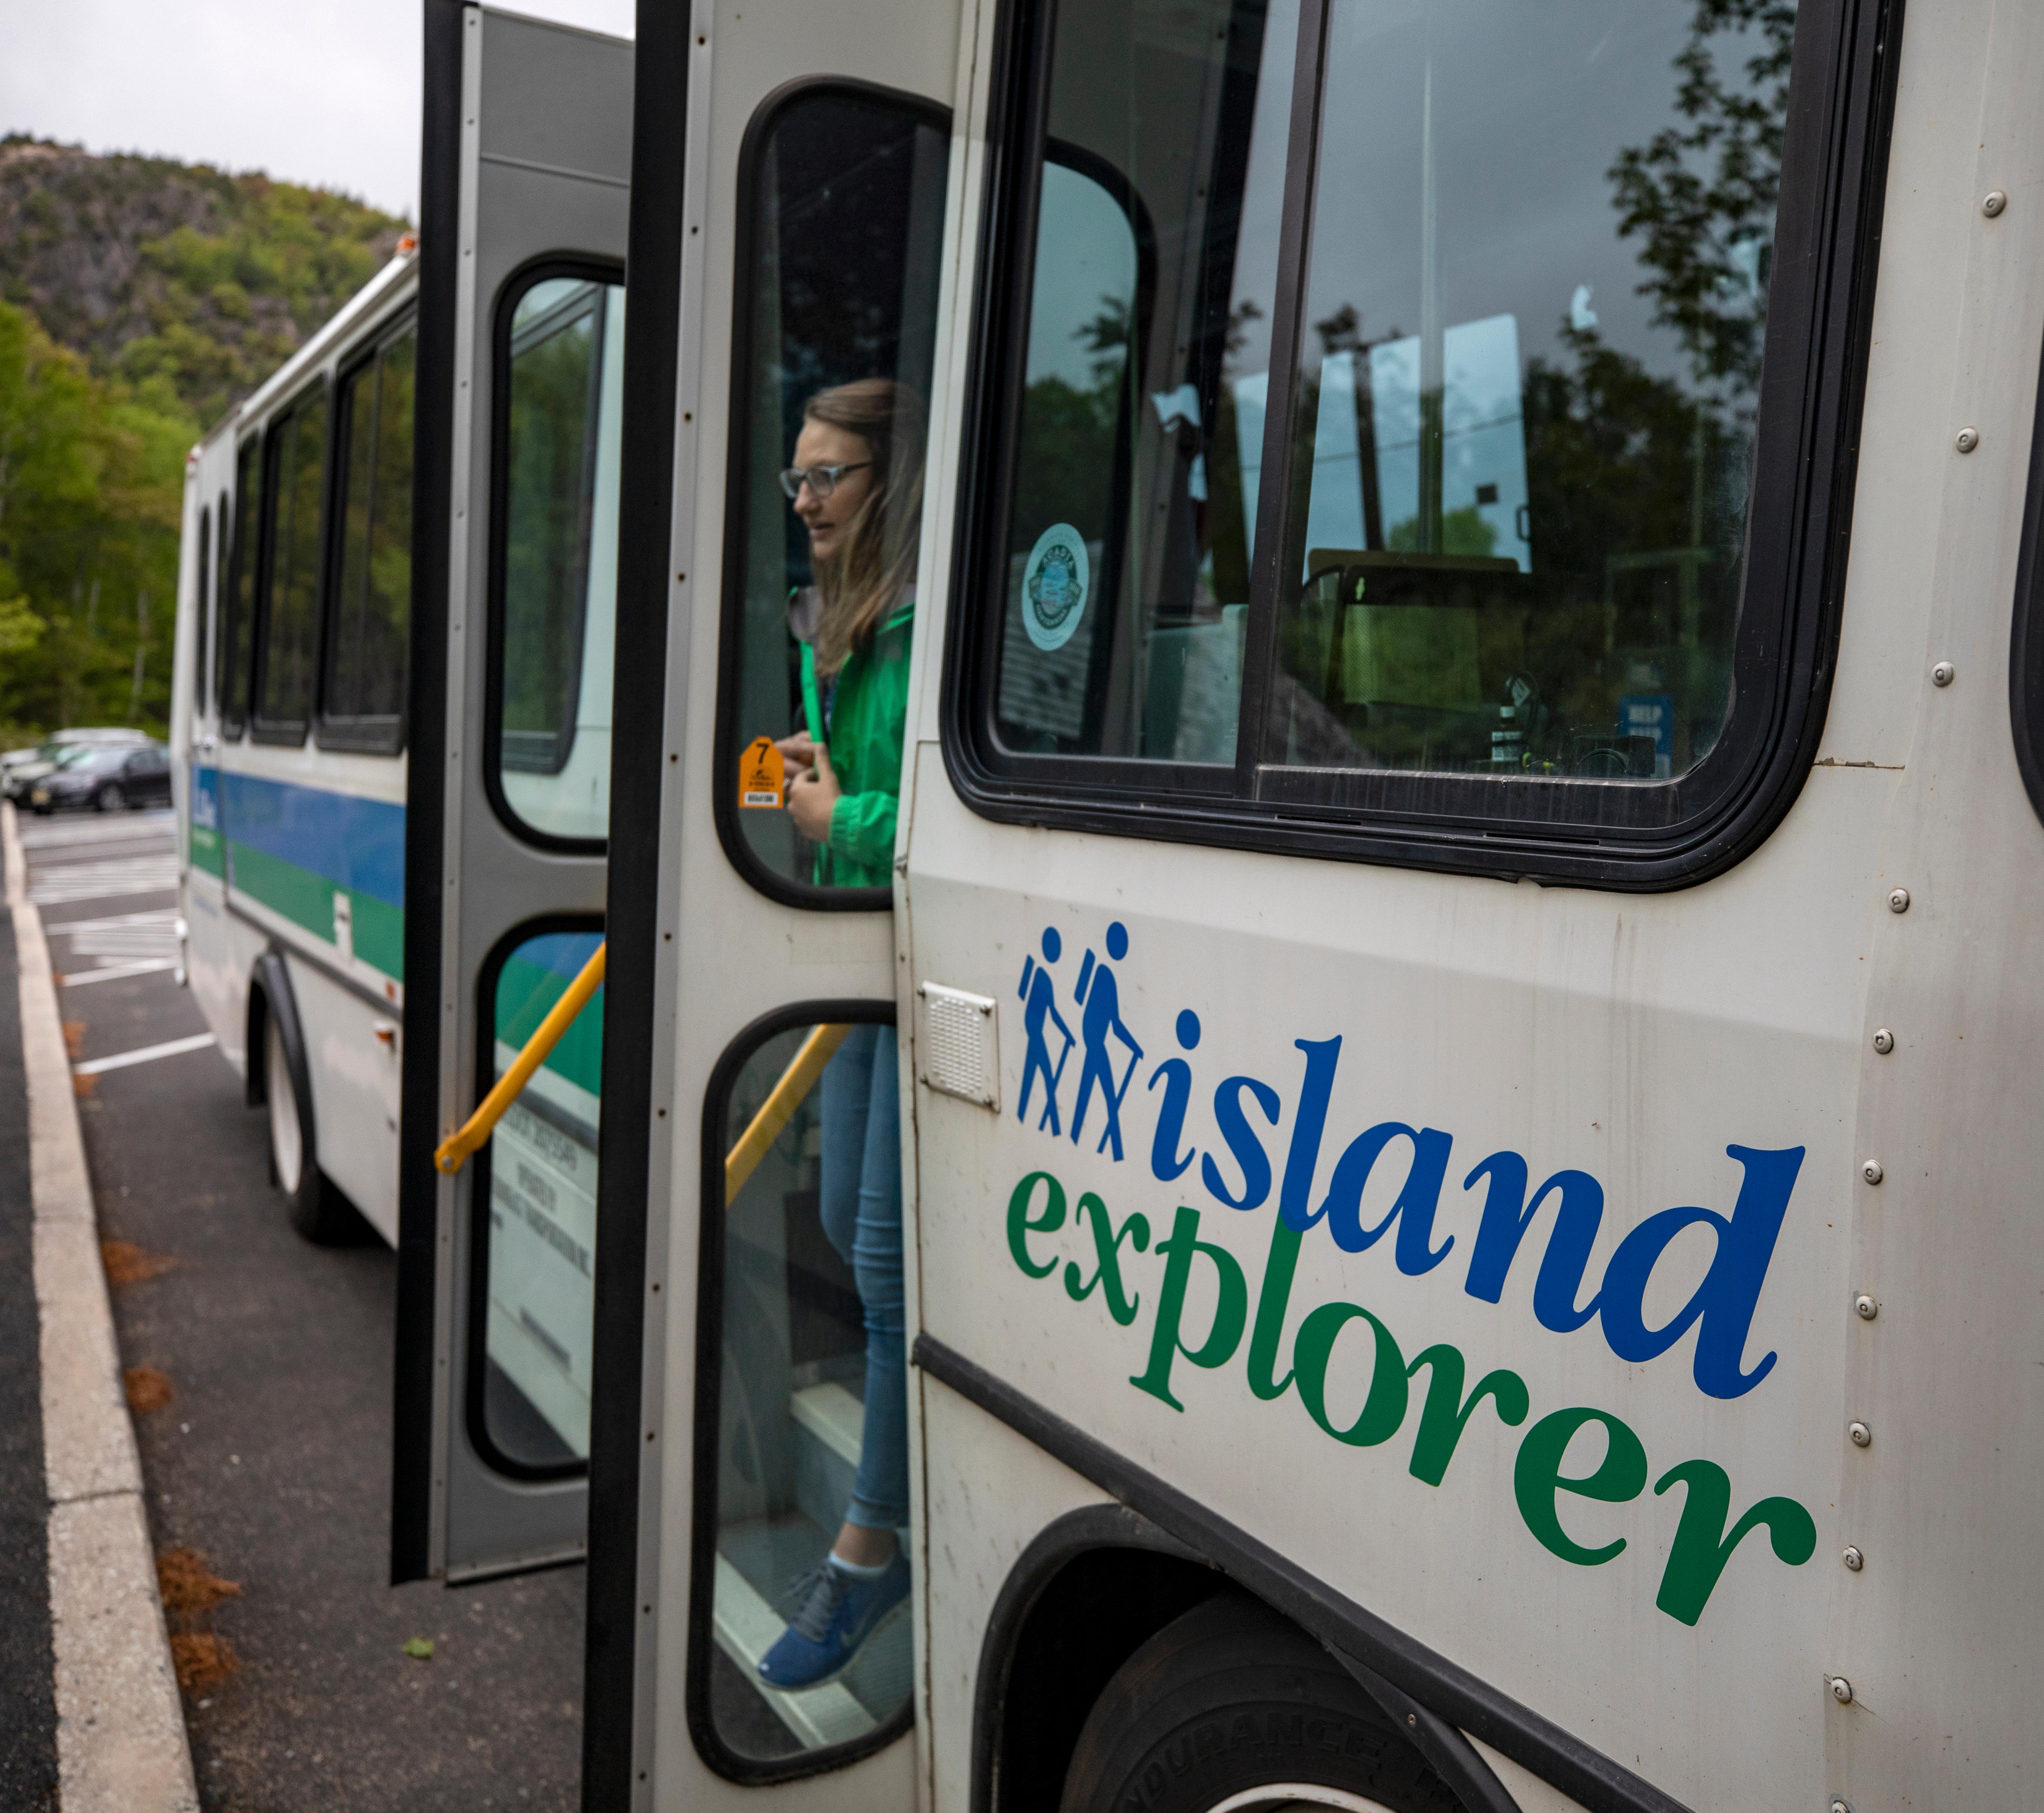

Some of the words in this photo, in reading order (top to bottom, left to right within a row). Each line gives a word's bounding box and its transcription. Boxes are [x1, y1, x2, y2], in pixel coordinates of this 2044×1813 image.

[757, 743, 770, 764] 7
[1006, 1171, 1816, 1627] explorer
[1148, 1009, 1805, 1399] island
